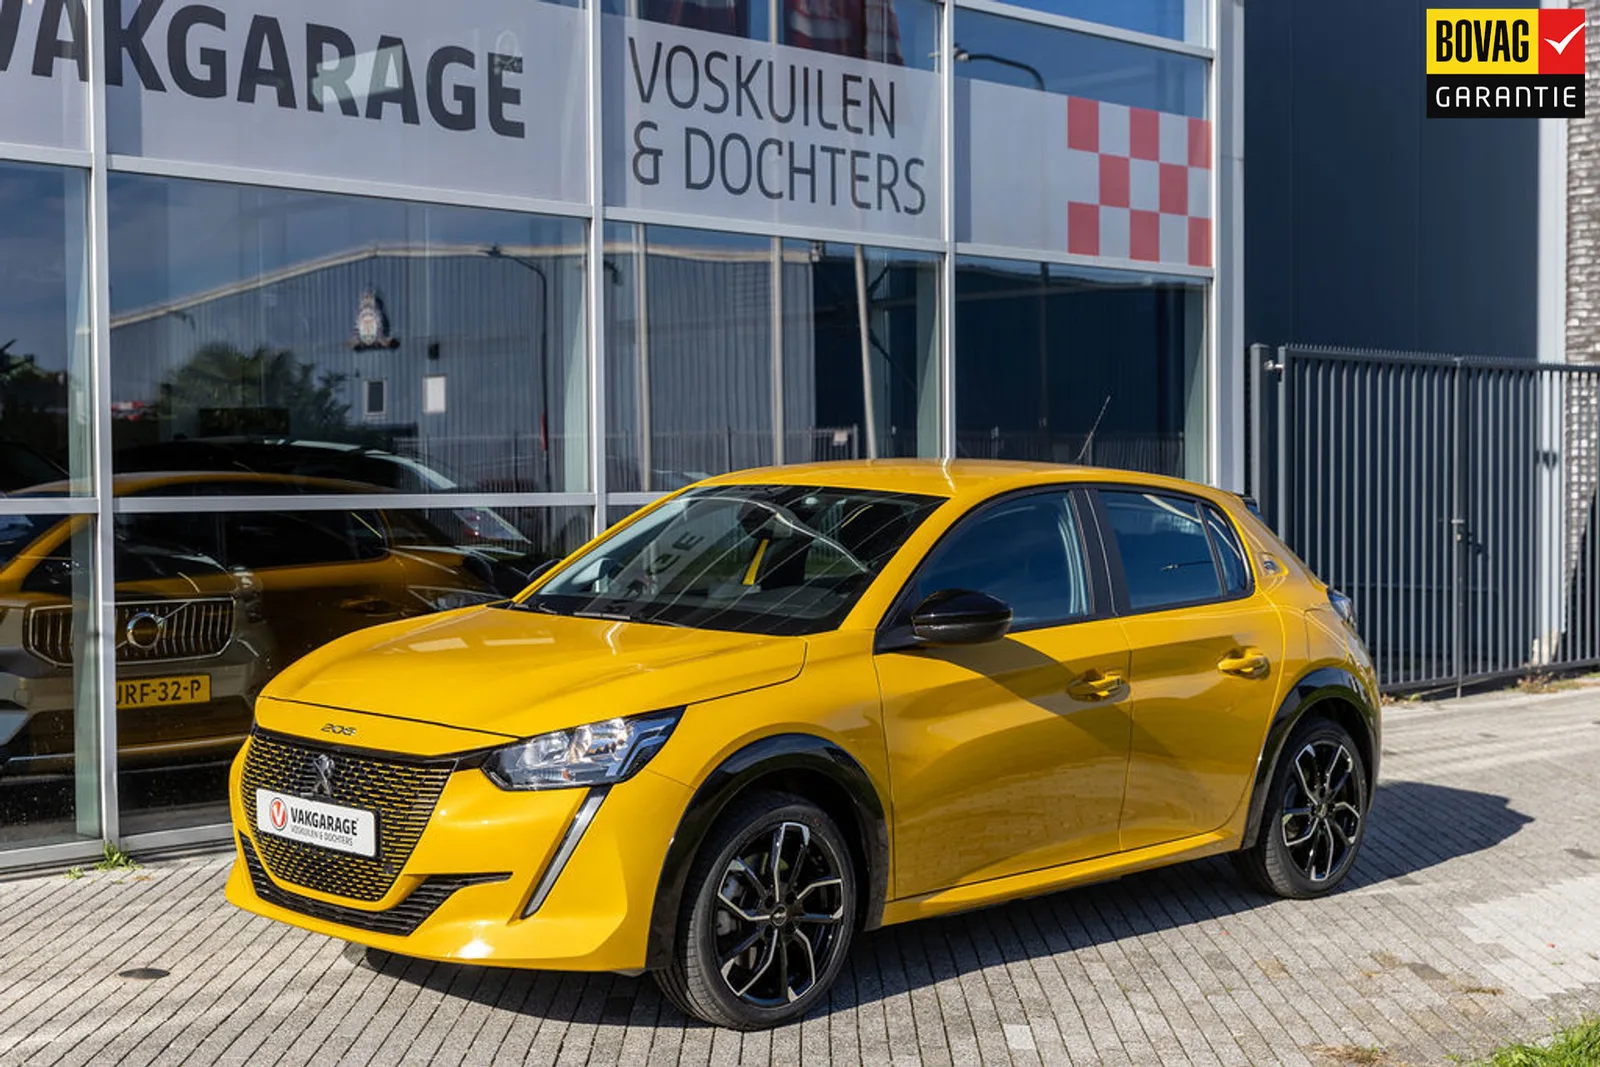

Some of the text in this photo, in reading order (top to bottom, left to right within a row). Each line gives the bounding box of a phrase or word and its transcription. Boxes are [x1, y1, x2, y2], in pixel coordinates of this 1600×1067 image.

[628, 37, 895, 138] VOSKUILEN
[632, 120, 926, 215] & DOCHTERS
[291, 807, 357, 836] VAKGARAGE
